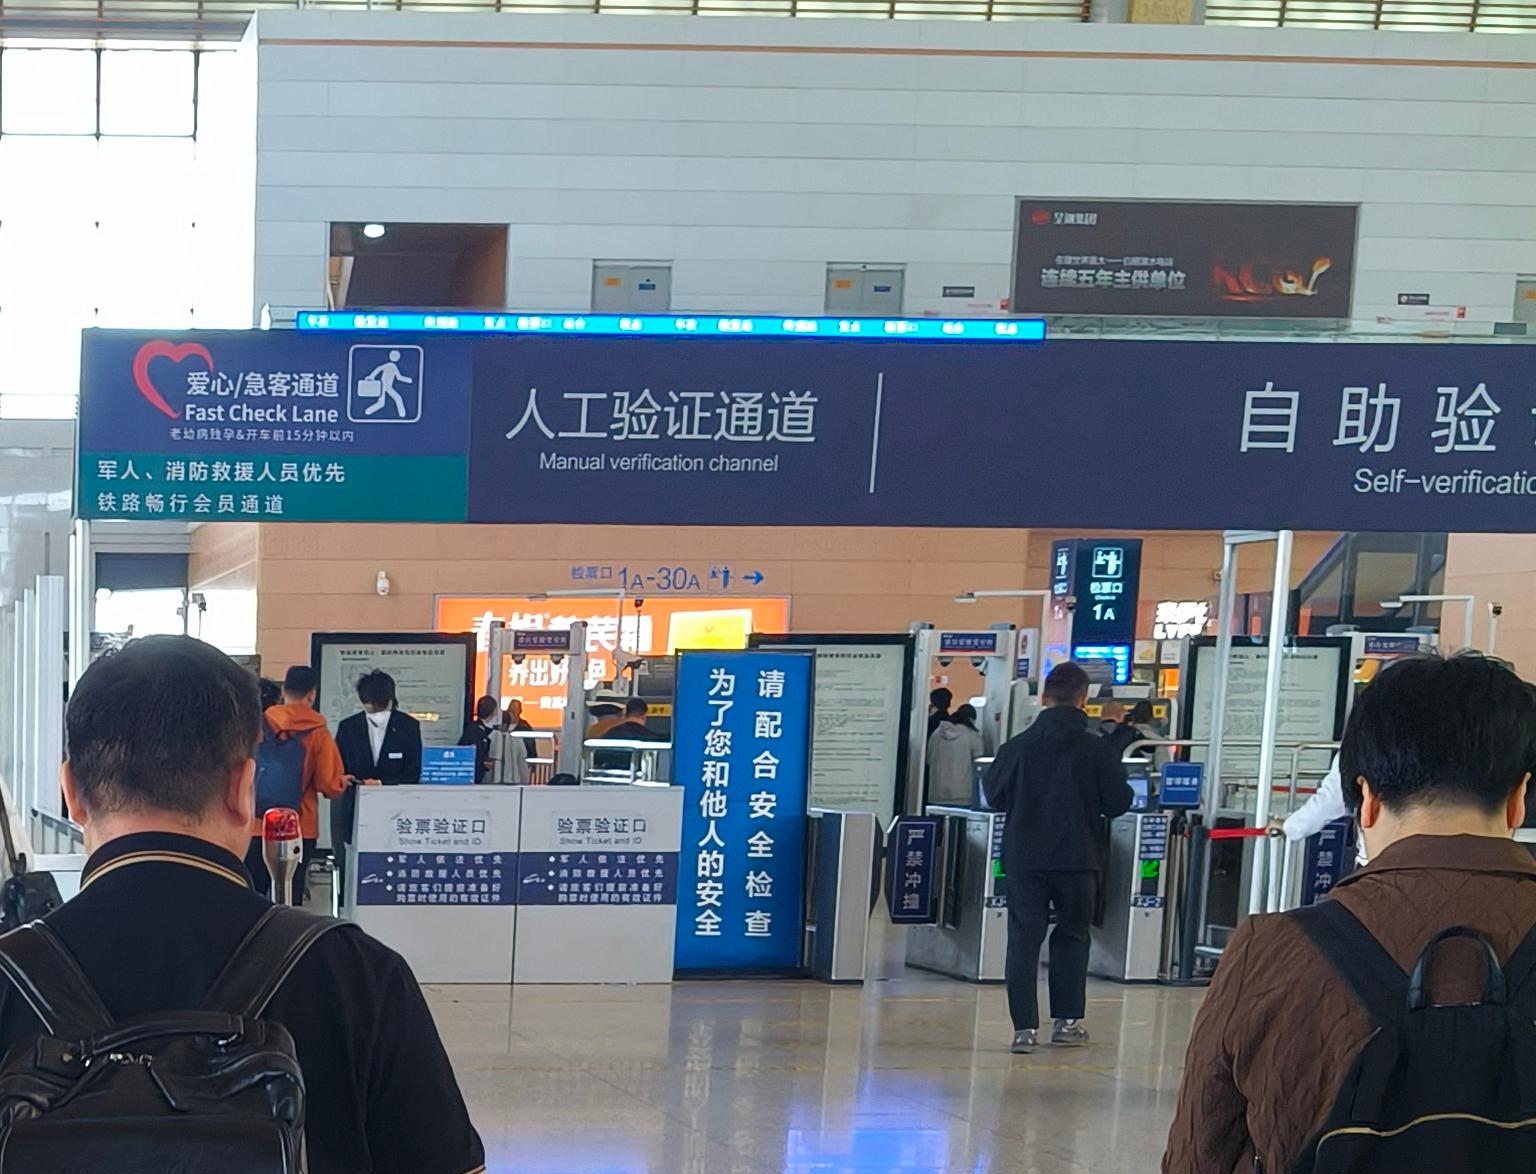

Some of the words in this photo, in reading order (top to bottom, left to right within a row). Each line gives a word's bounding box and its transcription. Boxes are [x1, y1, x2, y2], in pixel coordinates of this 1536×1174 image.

[186, 371, 340, 398] 爱心/急客通道
[185, 403, 225, 422] Fast
[228, 403, 286, 422] Check
[292, 405, 339, 423] Lane
[505, 388, 819, 442] 人工验证通道
[1239, 381, 1536, 453] 自助验
[97, 460, 346, 483] 军人、消防救援人员优先
[539, 452, 605, 470] Manual
[609, 453, 705, 471] verification
[708, 454, 780, 472] channel
[97, 492, 285, 515] 铁路畅行会员通道
[617, 567, 701, 590] 1A-30A
[1092, 603, 1116, 620] 1A
[694, 668, 736, 937] 为了您和他人的安全
[744, 669, 785, 937] 请配合安全检查
[396, 818, 486, 834] 验票验证口
[557, 818, 647, 834] 验票验证口
[586, 837, 612, 845] Ticket
[1314, 829, 1337, 903] 严禁冲
